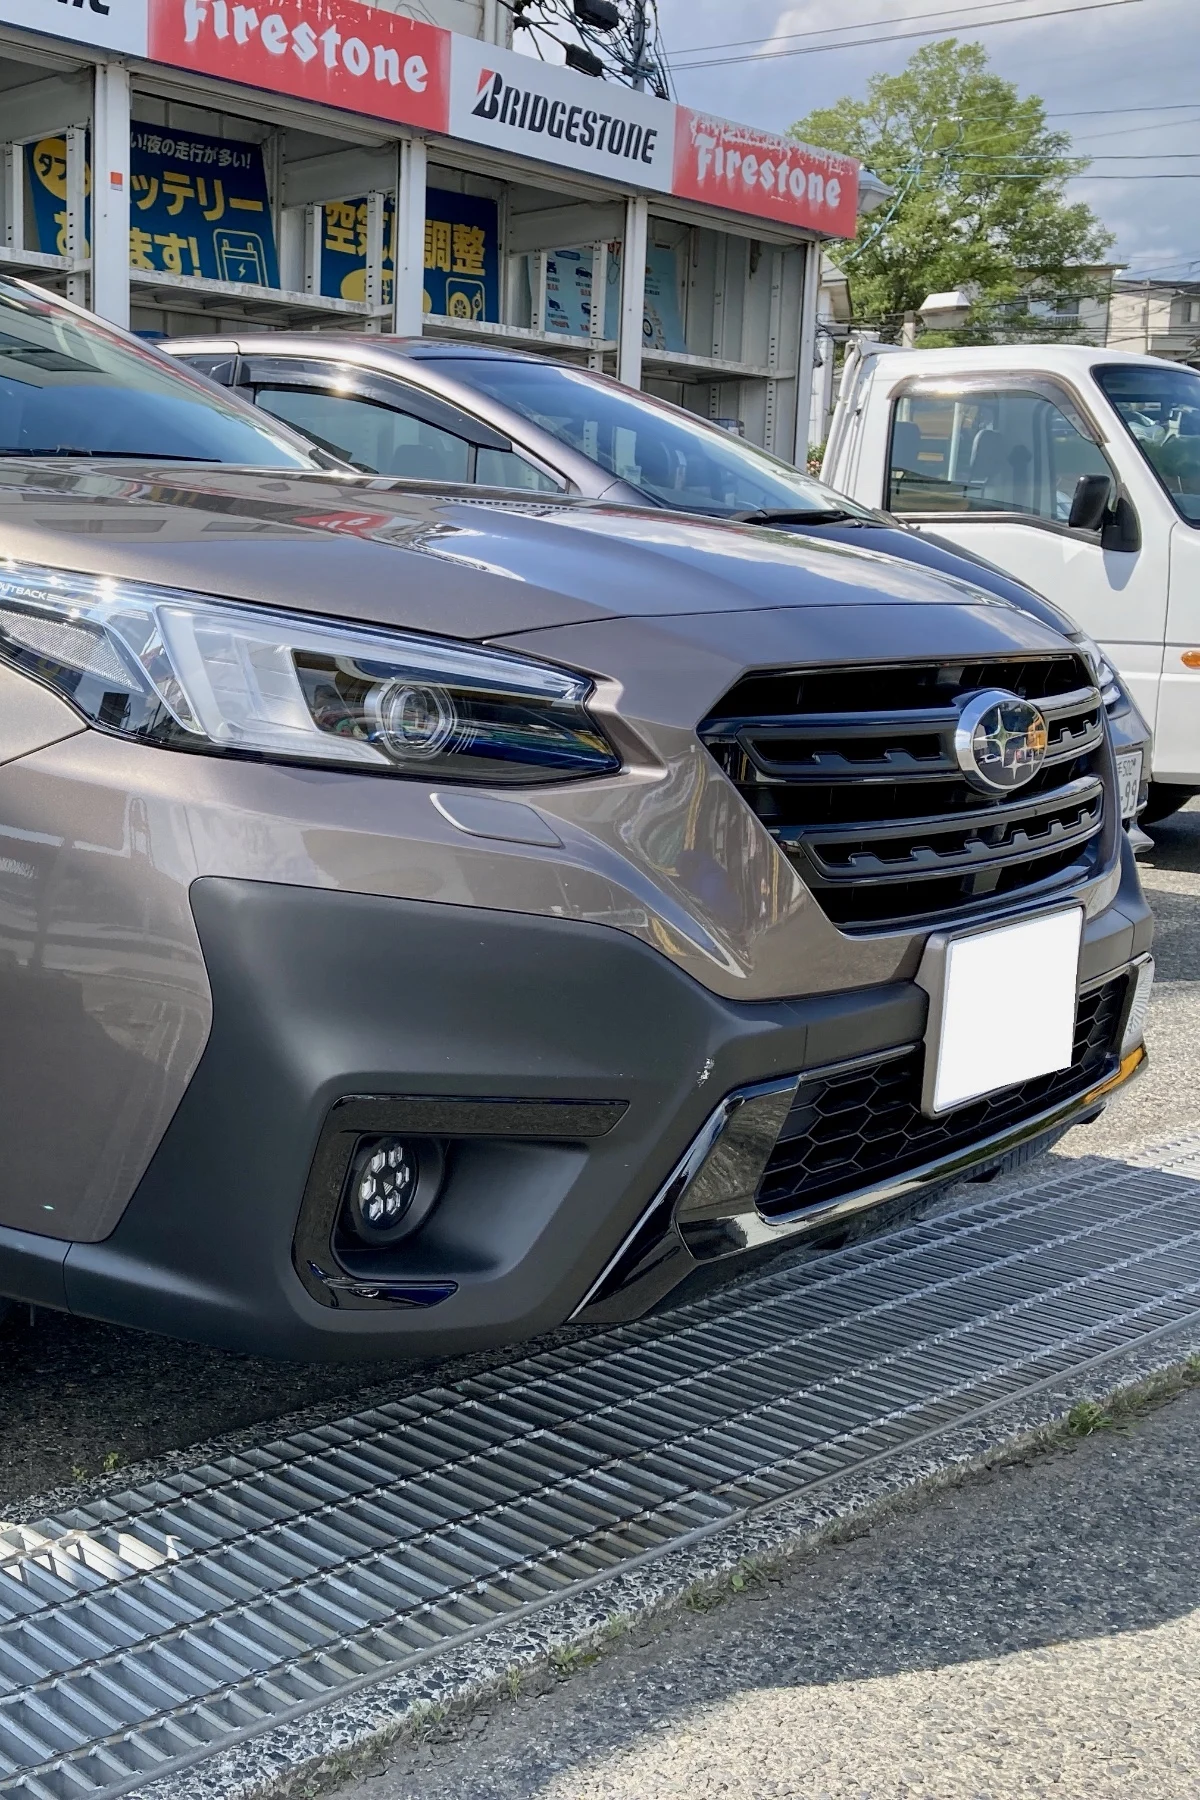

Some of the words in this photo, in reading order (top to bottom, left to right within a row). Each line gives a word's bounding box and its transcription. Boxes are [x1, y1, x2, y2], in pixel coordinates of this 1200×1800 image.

[183, 0, 428, 93] Firestone
[471, 68, 657, 165] BRIDGESTONE
[130, 170, 264, 222] ッテリー
[694, 132, 841, 208] Firestone
